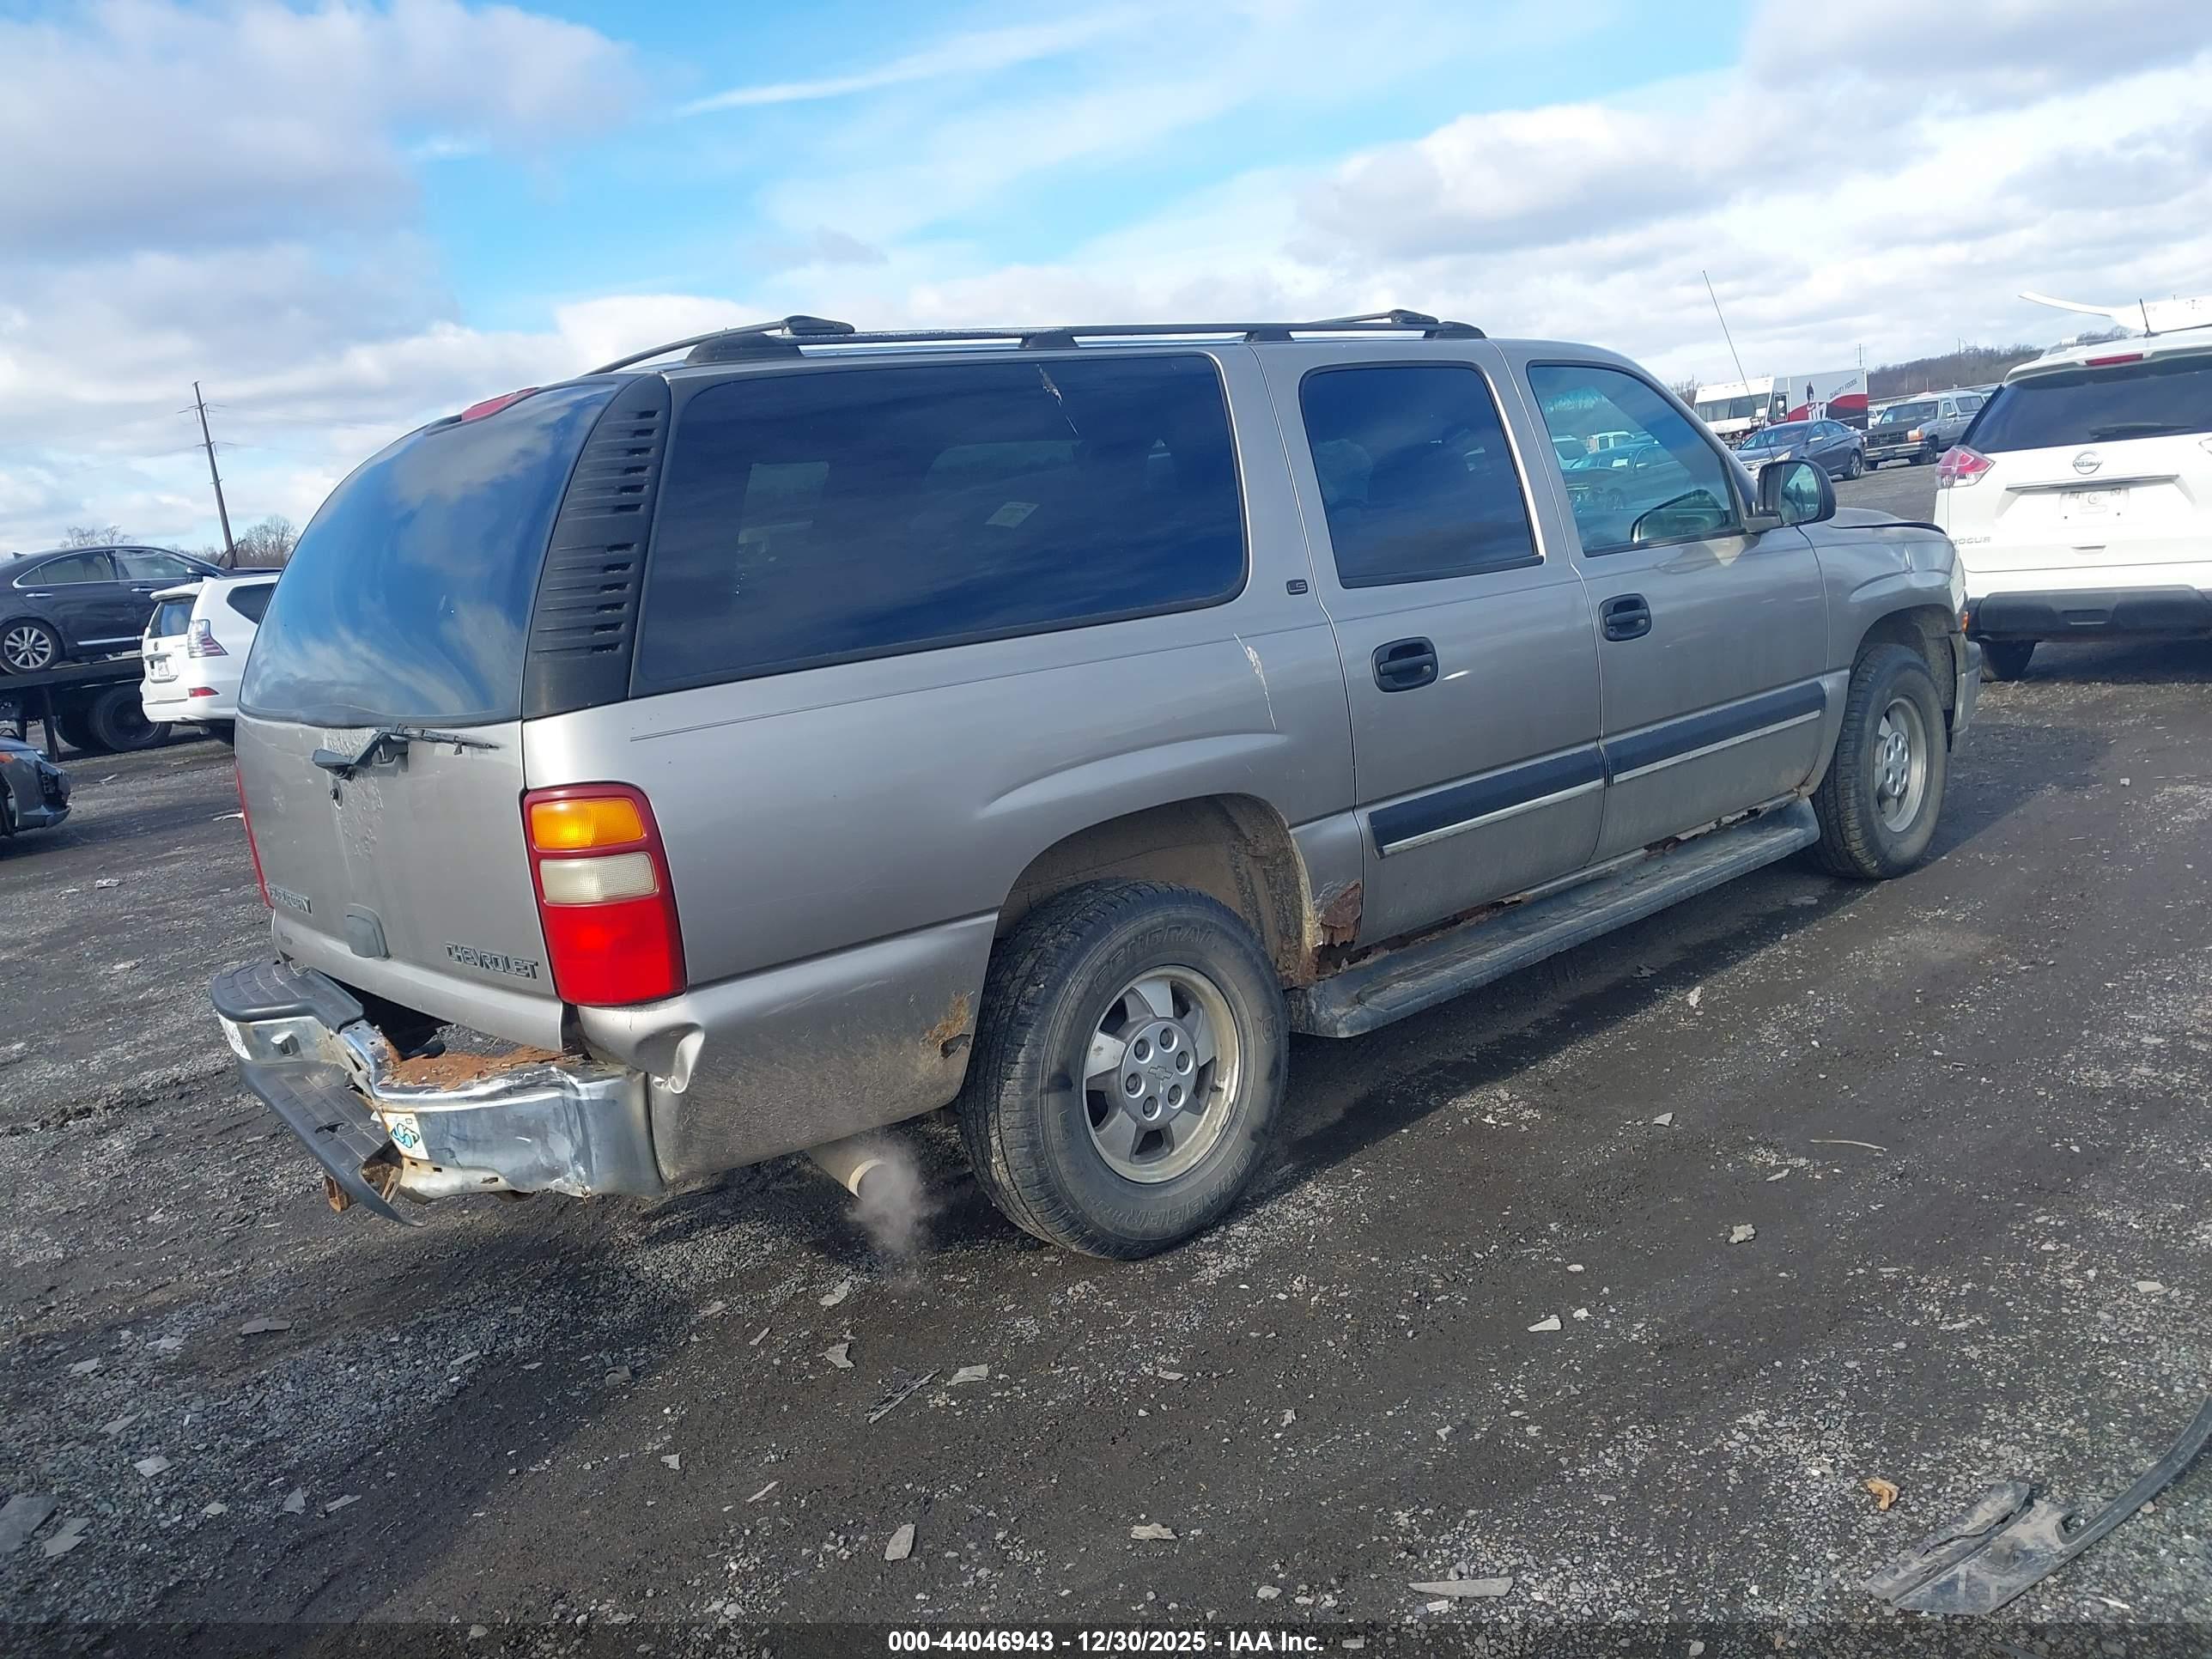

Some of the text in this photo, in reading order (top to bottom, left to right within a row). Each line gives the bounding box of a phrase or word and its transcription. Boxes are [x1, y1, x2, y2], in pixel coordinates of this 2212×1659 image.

[1829, 378, 1857, 399] QUALITY FOODS
[445, 942, 538, 980] CHEVROLET
